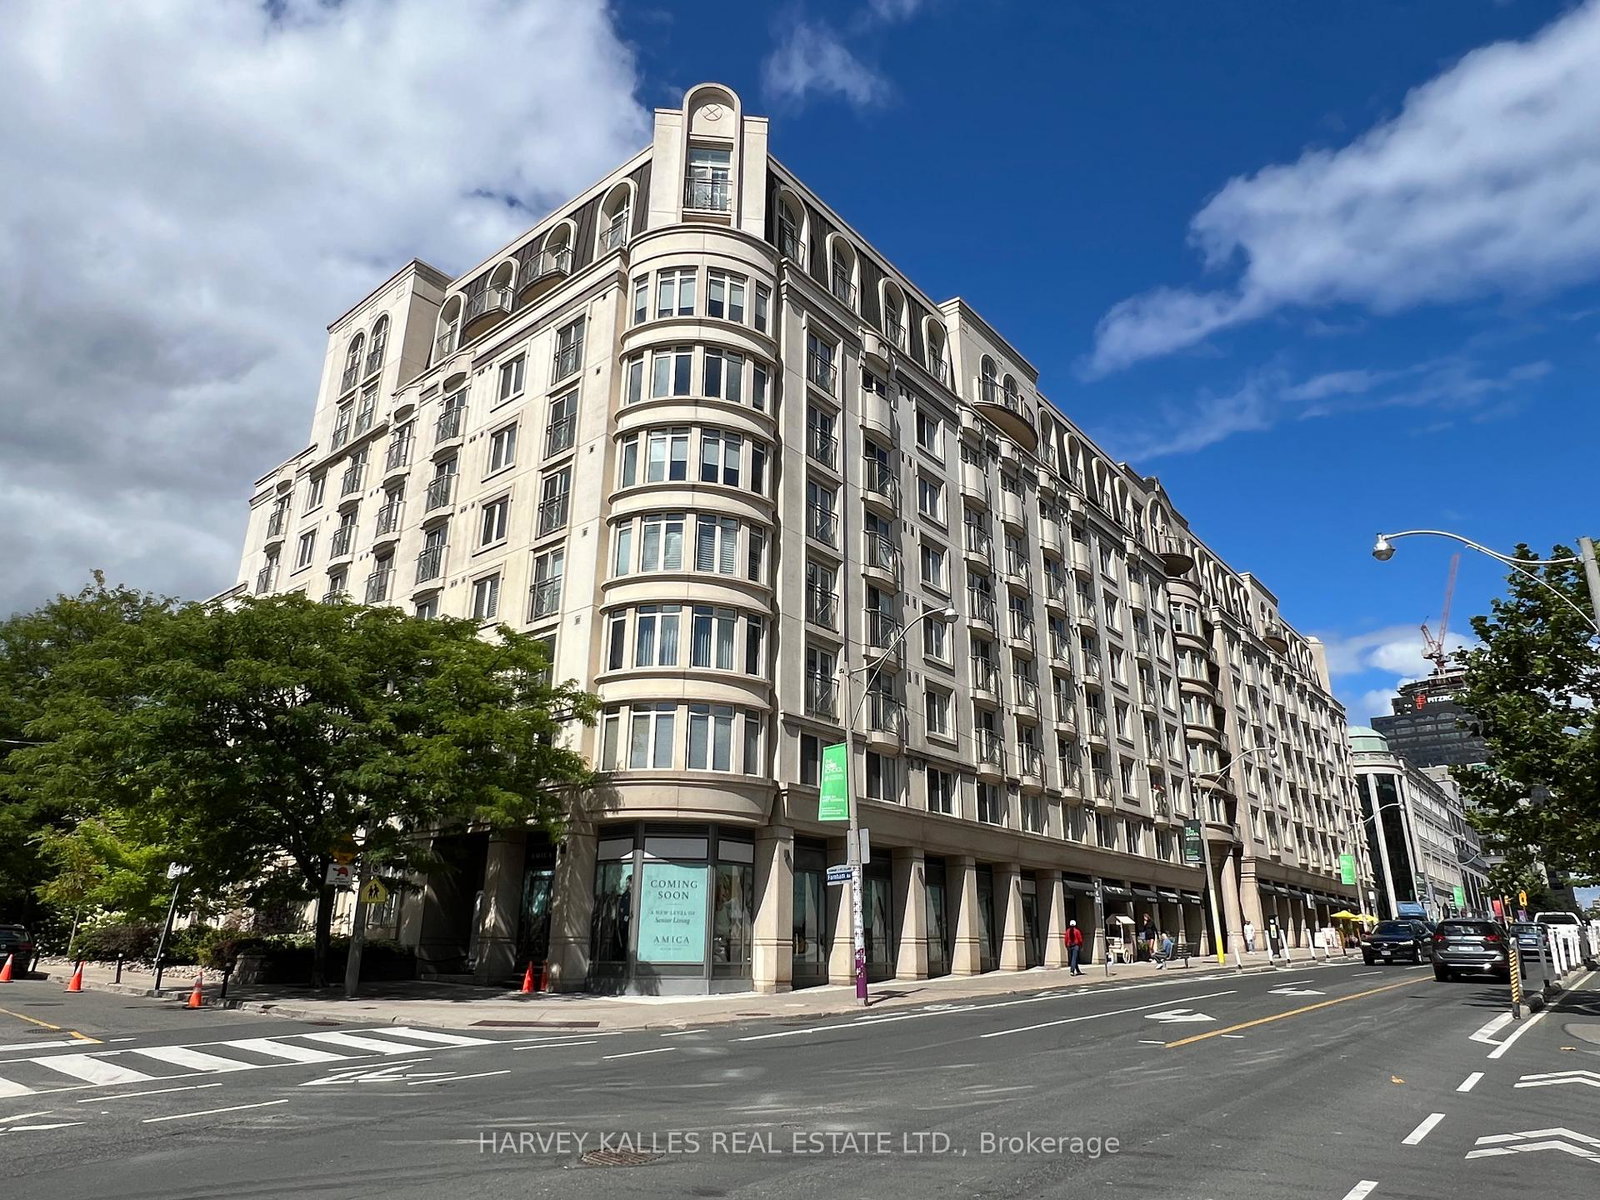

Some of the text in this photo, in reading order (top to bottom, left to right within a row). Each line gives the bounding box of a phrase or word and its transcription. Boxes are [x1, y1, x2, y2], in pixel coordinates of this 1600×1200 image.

[1427, 694, 1454, 703] FITZRO
[650, 879, 698, 889] COMING
[658, 891, 689, 900] SOON
[654, 936, 690, 944] AMICA
